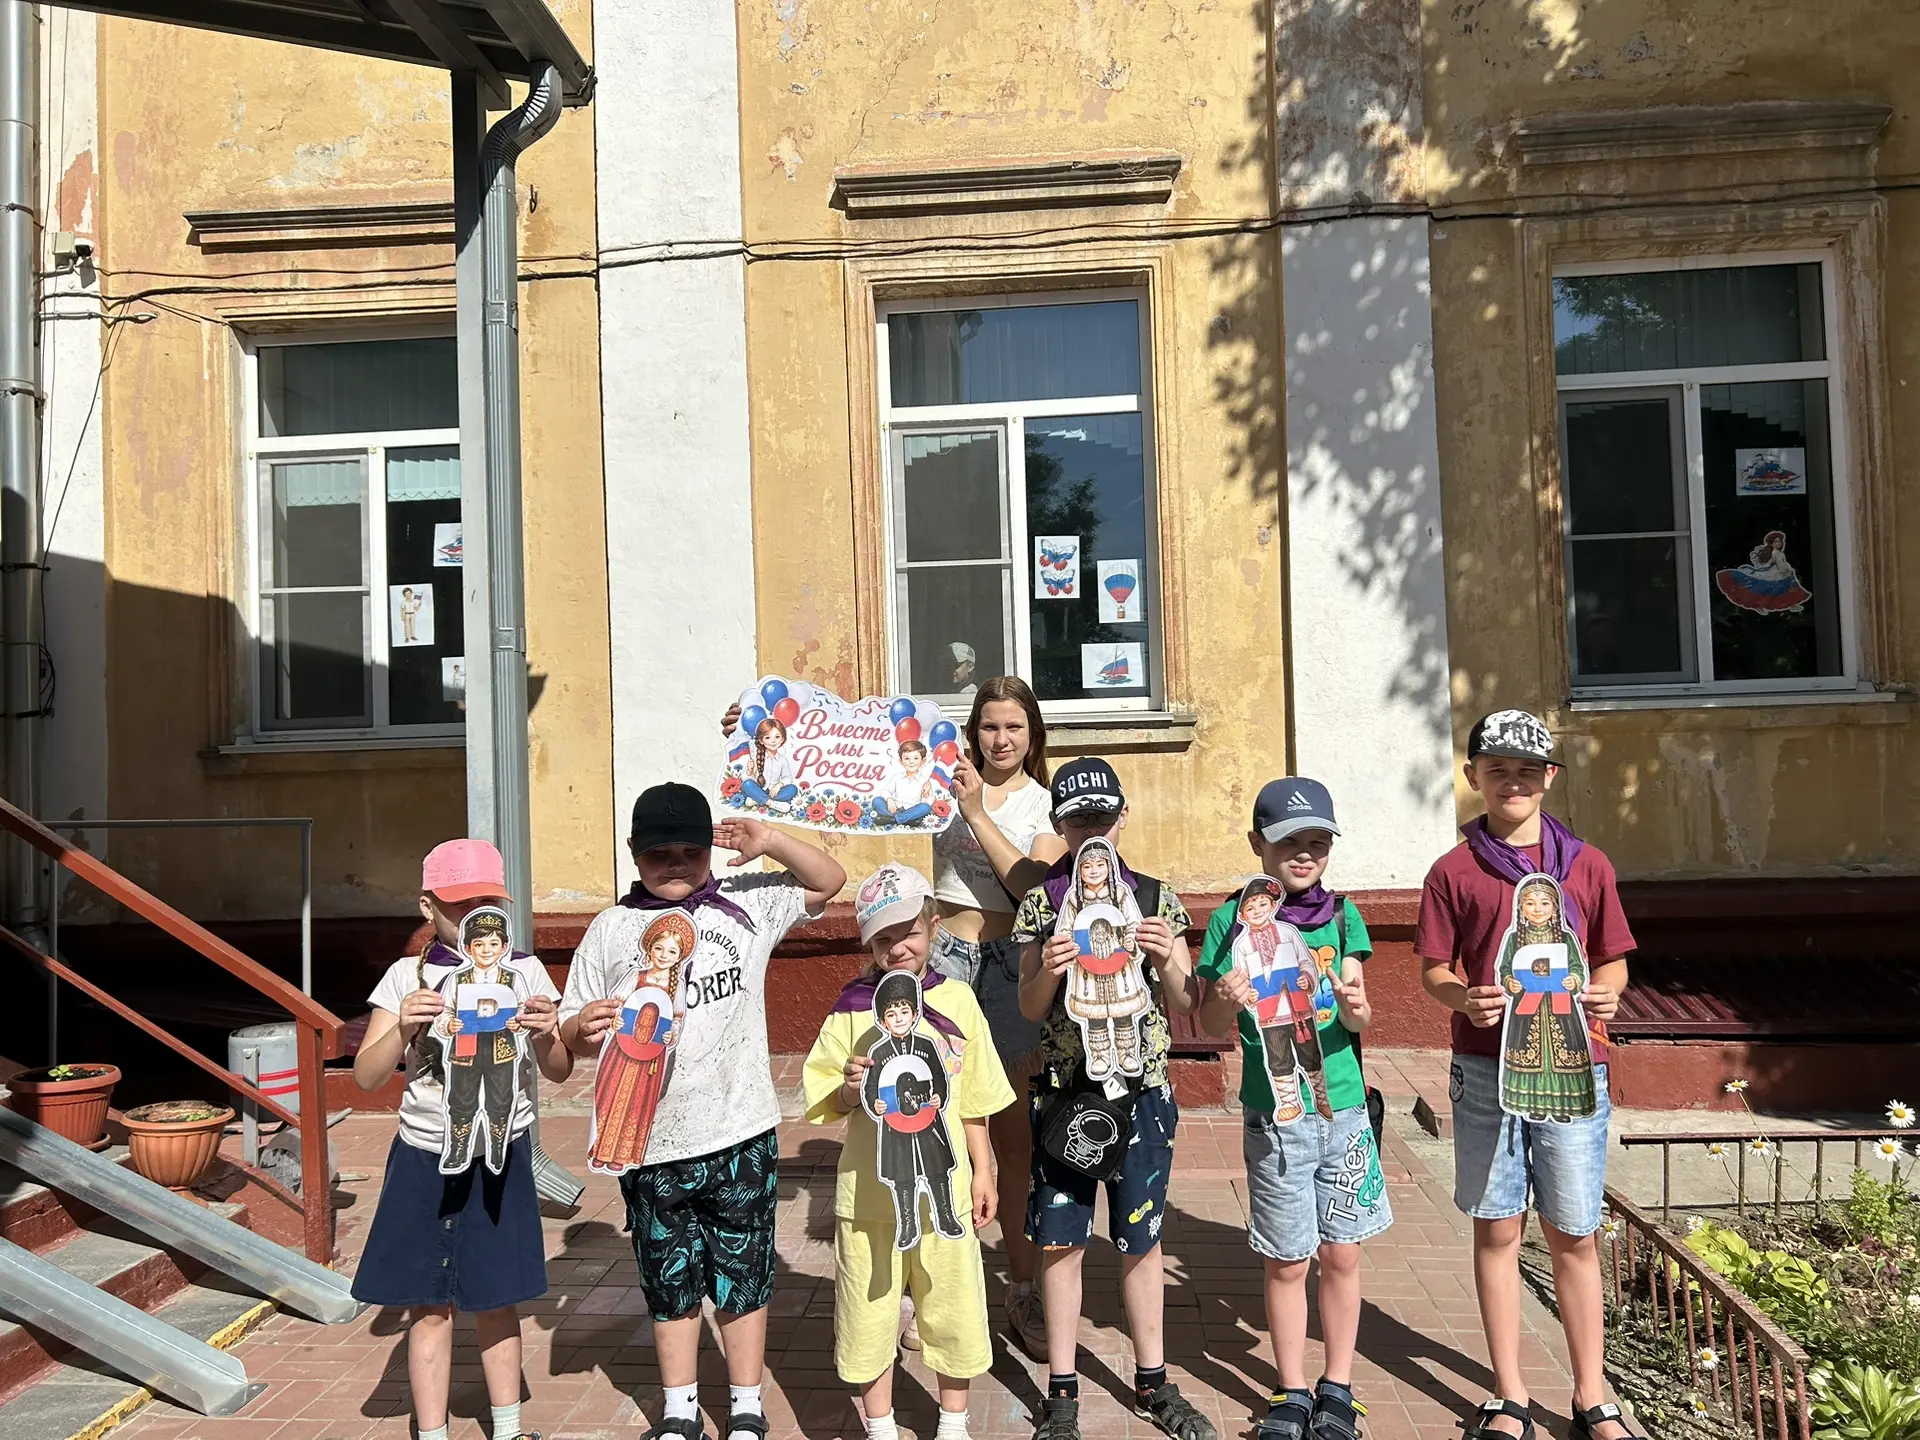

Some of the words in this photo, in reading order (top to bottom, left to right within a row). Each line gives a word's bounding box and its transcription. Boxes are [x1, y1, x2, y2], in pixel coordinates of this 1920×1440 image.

[796, 708, 891, 742] Вместе
[792, 744, 886, 781] Россия
[826, 742, 865, 757] мы
[1058, 771, 1108, 798] SOCHI
[1286, 804, 1313, 812] adidas
[686, 966, 744, 1009] ORER
[1511, 943, 1572, 1016] Я
[456, 983, 518, 1058] Р
[877, 1053, 937, 1134] С
[1325, 1129, 1366, 1223] T-Rex
